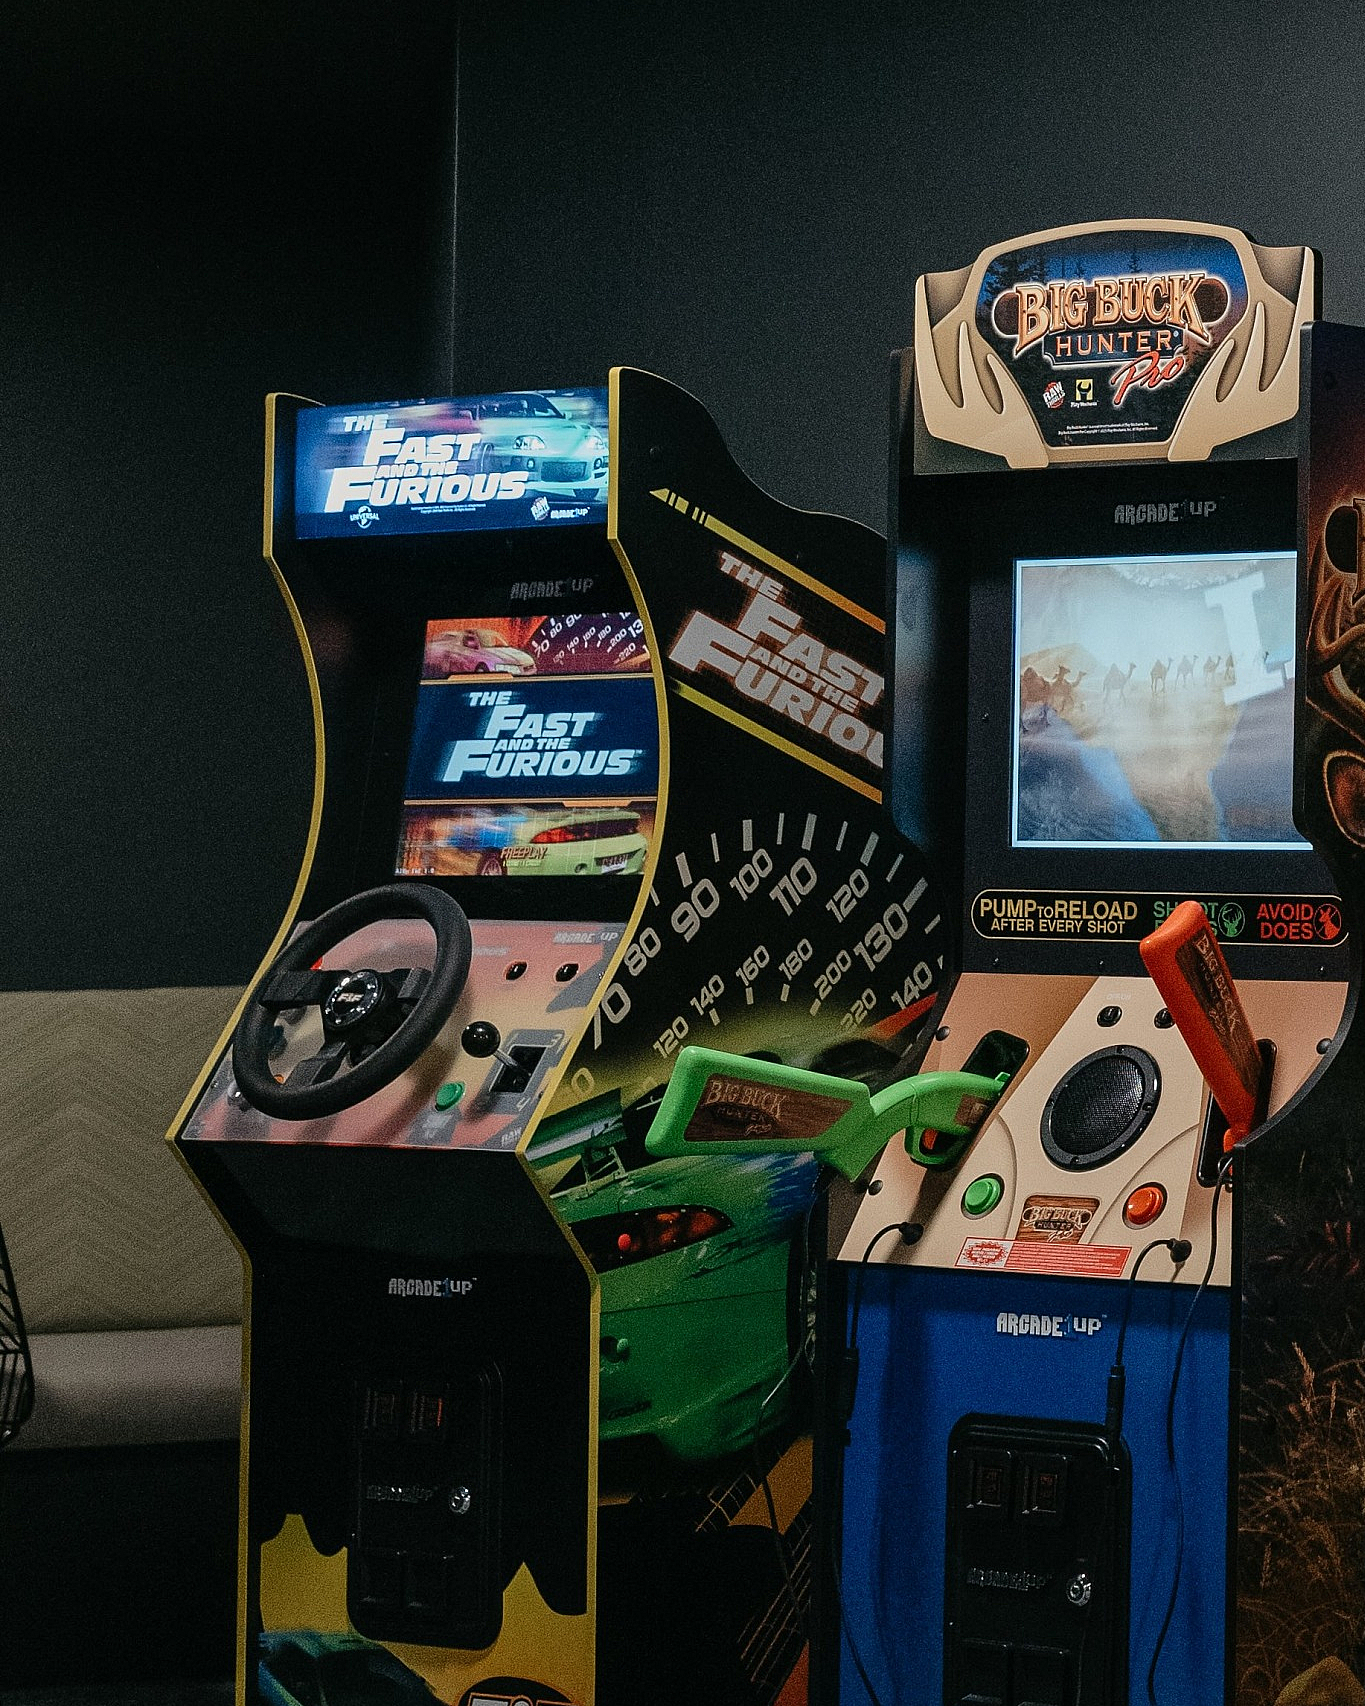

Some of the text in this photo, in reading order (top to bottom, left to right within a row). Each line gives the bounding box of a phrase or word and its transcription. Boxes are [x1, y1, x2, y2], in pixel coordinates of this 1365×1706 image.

[1015, 272, 1210, 356] BIG BUCK
[1055, 330, 1174, 358] HUNTER
[1111, 351, 1185, 406] Pro
[343, 414, 388, 432] THE
[363, 428, 481, 466] FAST
[325, 467, 529, 513] FURIOUS
[376, 461, 458, 478] AND THE
[720, 551, 784, 600] THE
[737, 593, 884, 706] FAST
[470, 691, 512, 706] THE
[752, 646, 859, 712] AND THE
[484, 704, 595, 739] FAST
[443, 740, 636, 783] FURIOUS
[495, 738, 571, 751] AND THE
[501, 846, 548, 860] FREEPLAY
[729, 848, 774, 901] 100
[769, 857, 818, 916] 110
[825, 869, 870, 923] 120
[671, 878, 720, 943] 90
[980, 899, 1036, 918] PUMP
[1054, 900, 1138, 920] RELOAD
[990, 918, 1125, 934] AFTER EVERY SHOT
[1257, 903, 1314, 921] AVOID
[1260, 922, 1313, 940] DOES
[624, 927, 662, 977] 80
[853, 903, 909, 972] 130
[735, 945, 770, 987] 160
[778, 938, 813, 982] 180
[813, 949, 853, 1000] 200
[690, 975, 725, 1016] 140
[891, 961, 934, 1010] 140
[653, 1016, 689, 1059] 120
[705, 1081, 788, 1120] BIG BUCK
[1029, 1207, 1082, 1227] BIG BUCK
